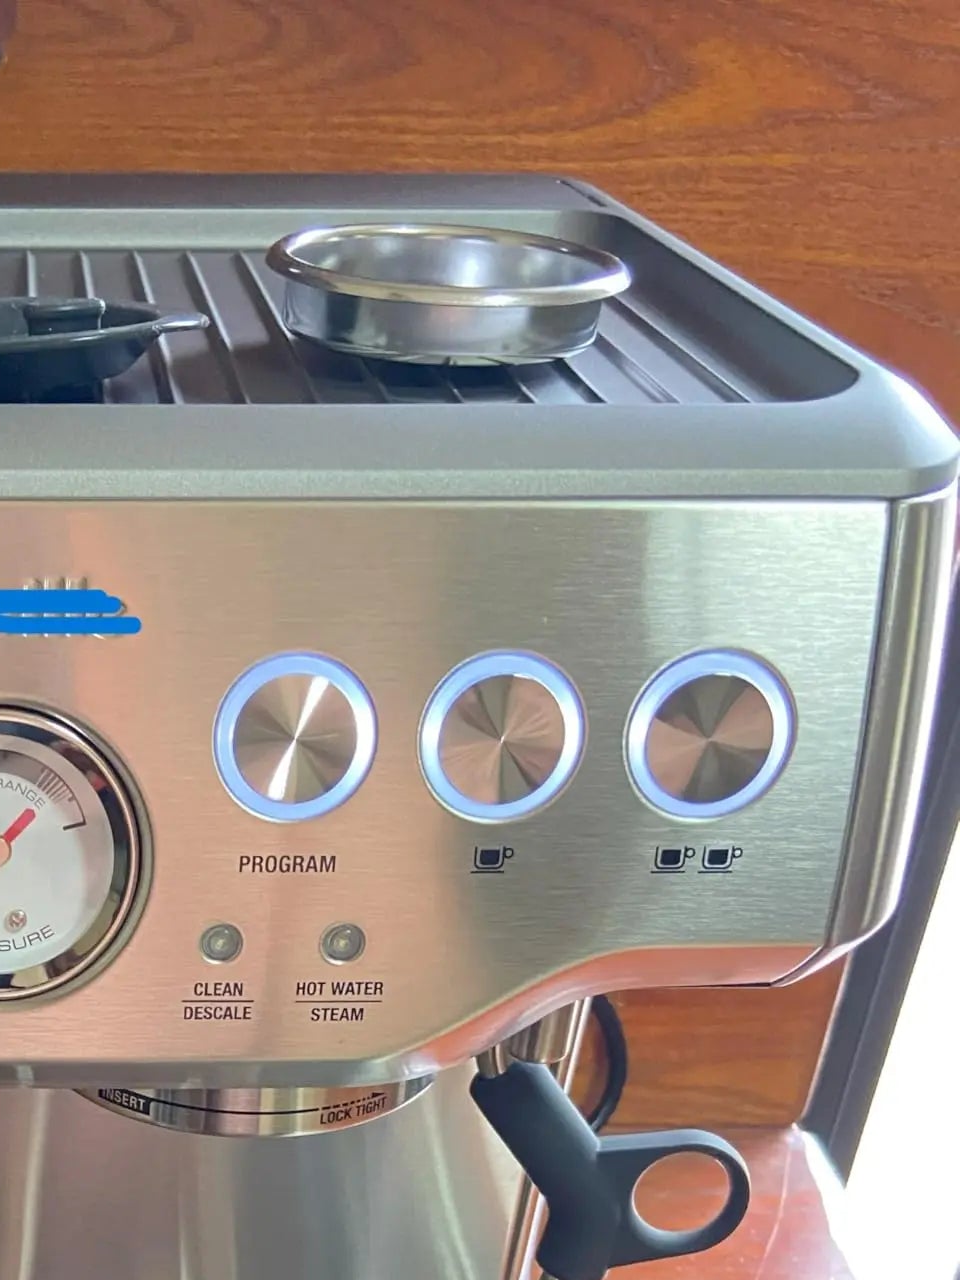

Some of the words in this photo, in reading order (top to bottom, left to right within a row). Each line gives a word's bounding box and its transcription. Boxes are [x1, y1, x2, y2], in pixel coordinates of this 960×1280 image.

[238, 855, 337, 874] PROGRAM
[193, 981, 244, 997] CLEAN
[295, 980, 327, 997] HOT
[330, 980, 384, 997] WATER
[183, 1005, 252, 1022] DESCALE
[310, 1006, 365, 1022] STEAM
[319, 1106, 353, 1126] LOCK
[355, 1095, 388, 1119] TIGHT
